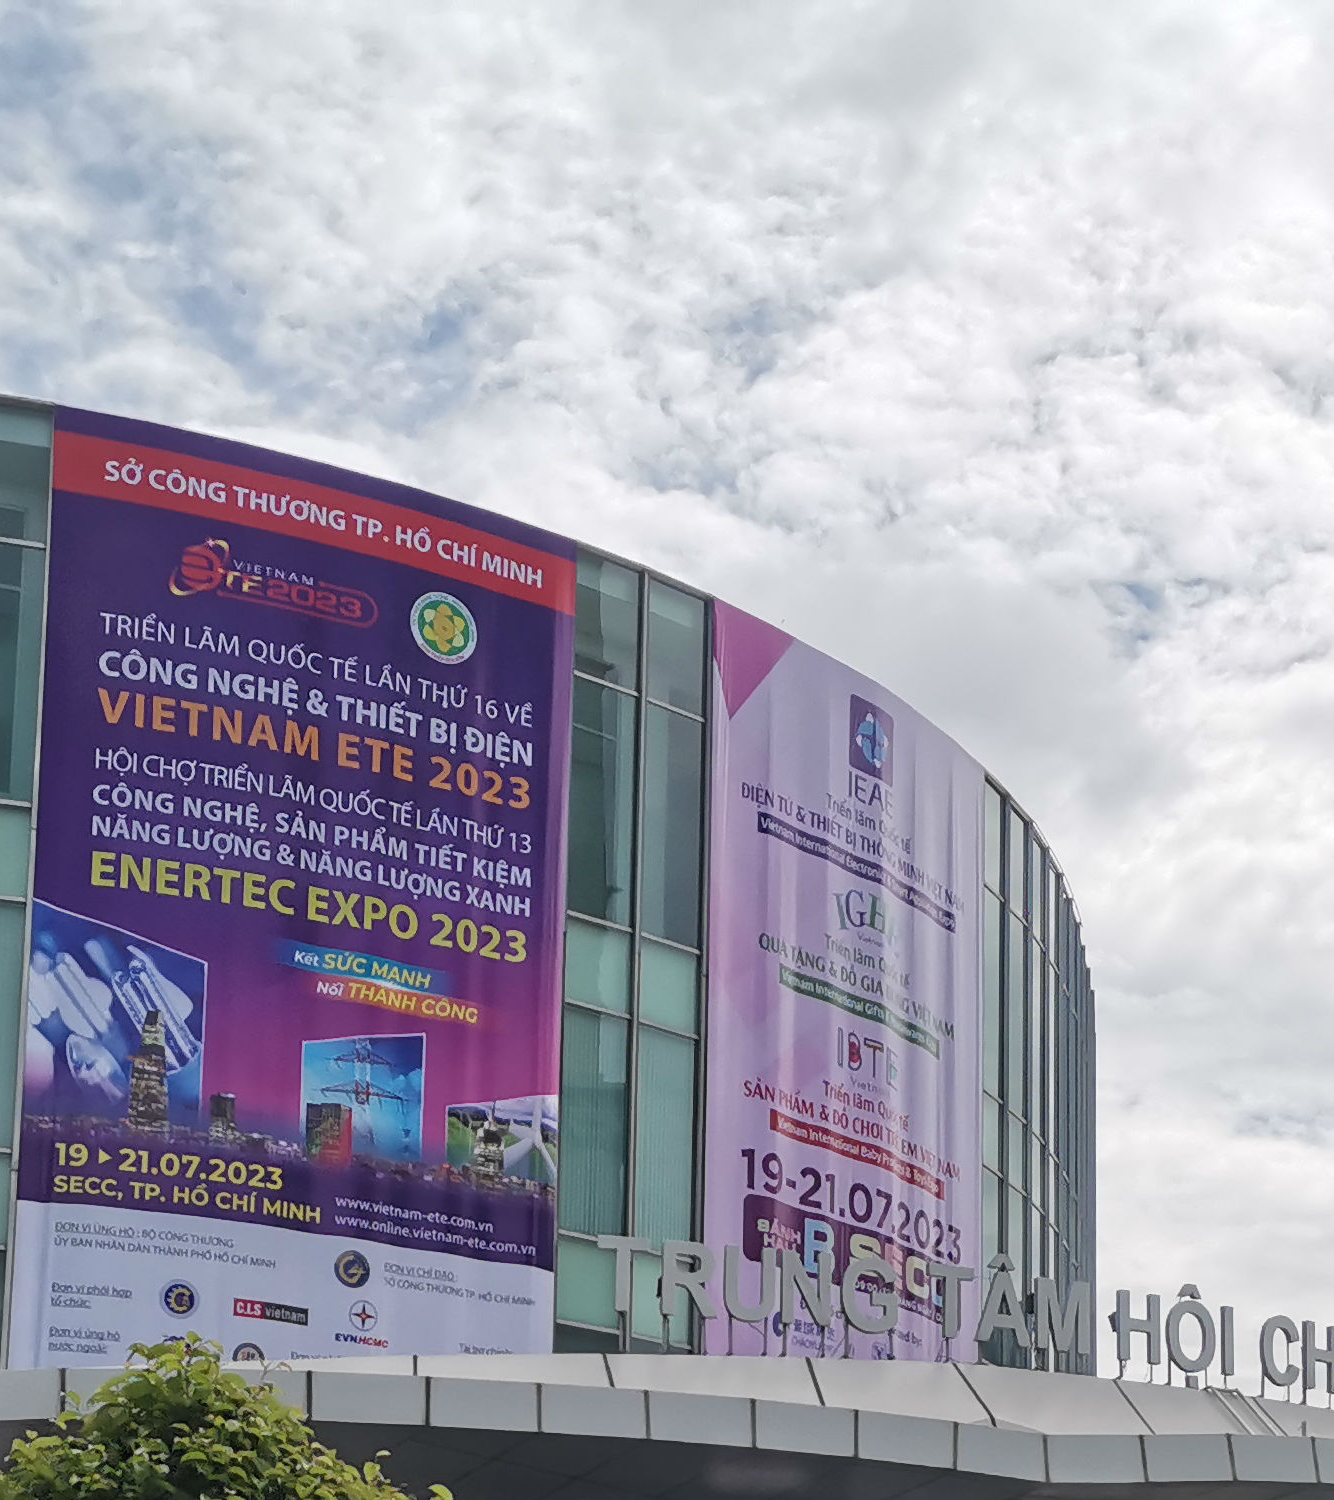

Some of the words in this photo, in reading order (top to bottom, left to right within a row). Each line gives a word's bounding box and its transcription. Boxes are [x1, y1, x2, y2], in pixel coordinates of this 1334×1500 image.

[104, 457, 143, 485] SỞ
[148, 469, 226, 503] CÔNG
[233, 486, 346, 531] THƯƠNG
[352, 514, 389, 542] TP.
[395, 526, 432, 552] HỒ
[437, 540, 478, 567] CHÍ
[482, 551, 543, 588] MINH
[233, 559, 314, 586] VIETNAM
[98, 649, 198, 689] CÔNG
[208, 667, 299, 715] NGHỆ
[306, 689, 328, 718] &
[336, 694, 423, 738] THIẾT
[430, 717, 457, 754] BỊ
[464, 726, 533, 768] ĐIỆN
[100, 613, 175, 645] TRIỂN
[184, 626, 240, 657] LÃM
[248, 639, 323, 676] QUỐC
[328, 656, 358, 683] TẾ
[475, 695, 499, 719] 16
[95, 747, 137, 776] HỘI
[142, 755, 197, 786] CHỢ
[199, 763, 263, 794] TRIỂN
[268, 774, 315, 806] LÃM
[320, 788, 387, 820] QUỐC
[388, 800, 414, 827] TẾ
[461, 818, 504, 849] THỨ
[509, 832, 532, 854] 13
[97, 687, 319, 761] VIETNAM
[338, 732, 413, 782] ETE
[429, 756, 530, 809] 2023
[91, 813, 171, 846] NĂNG
[177, 826, 271, 860] LƯỢNG
[276, 844, 295, 866] &
[300, 849, 372, 882] NĂNG
[378, 864, 460, 901] LƯỢNG
[466, 884, 531, 918] XANH
[92, 782, 175, 814] CÔNG
[183, 796, 267, 833] NGHỆ,
[275, 810, 326, 843] SẢN
[334, 826, 407, 861] PHẨM
[415, 843, 467, 872] TIẾT
[473, 856, 532, 889] KIỆM
[91, 850, 296, 916] ENERTEC
[307, 885, 418, 940] EXPO
[430, 913, 527, 963] 2023
[294, 950, 319, 967] Kết
[323, 952, 367, 974] SỨC
[421, 998, 478, 1024] CÔNG
[53, 1175, 124, 1201] SECC,
[129, 1181, 166, 1202] TP.
[173, 1183, 209, 1206] HỒ
[215, 1191, 257, 1214] CHÍ
[262, 1198, 321, 1225] MINH
[55, 1143, 88, 1167] 19
[118, 1148, 283, 1191] 21.07.2023
[334, 1196, 493, 1234] www.vietnam-ete.com.vn
[741, 1148, 961, 1265] 19-21.07.2023
[334, 1214, 536, 1257] www.online.vietnam-ete.com.vn
[597, 1234, 902, 1335] TRUNG
[928, 1254, 1091, 1355] TÂM
[1111, 1284, 1234, 1390] HỘI
